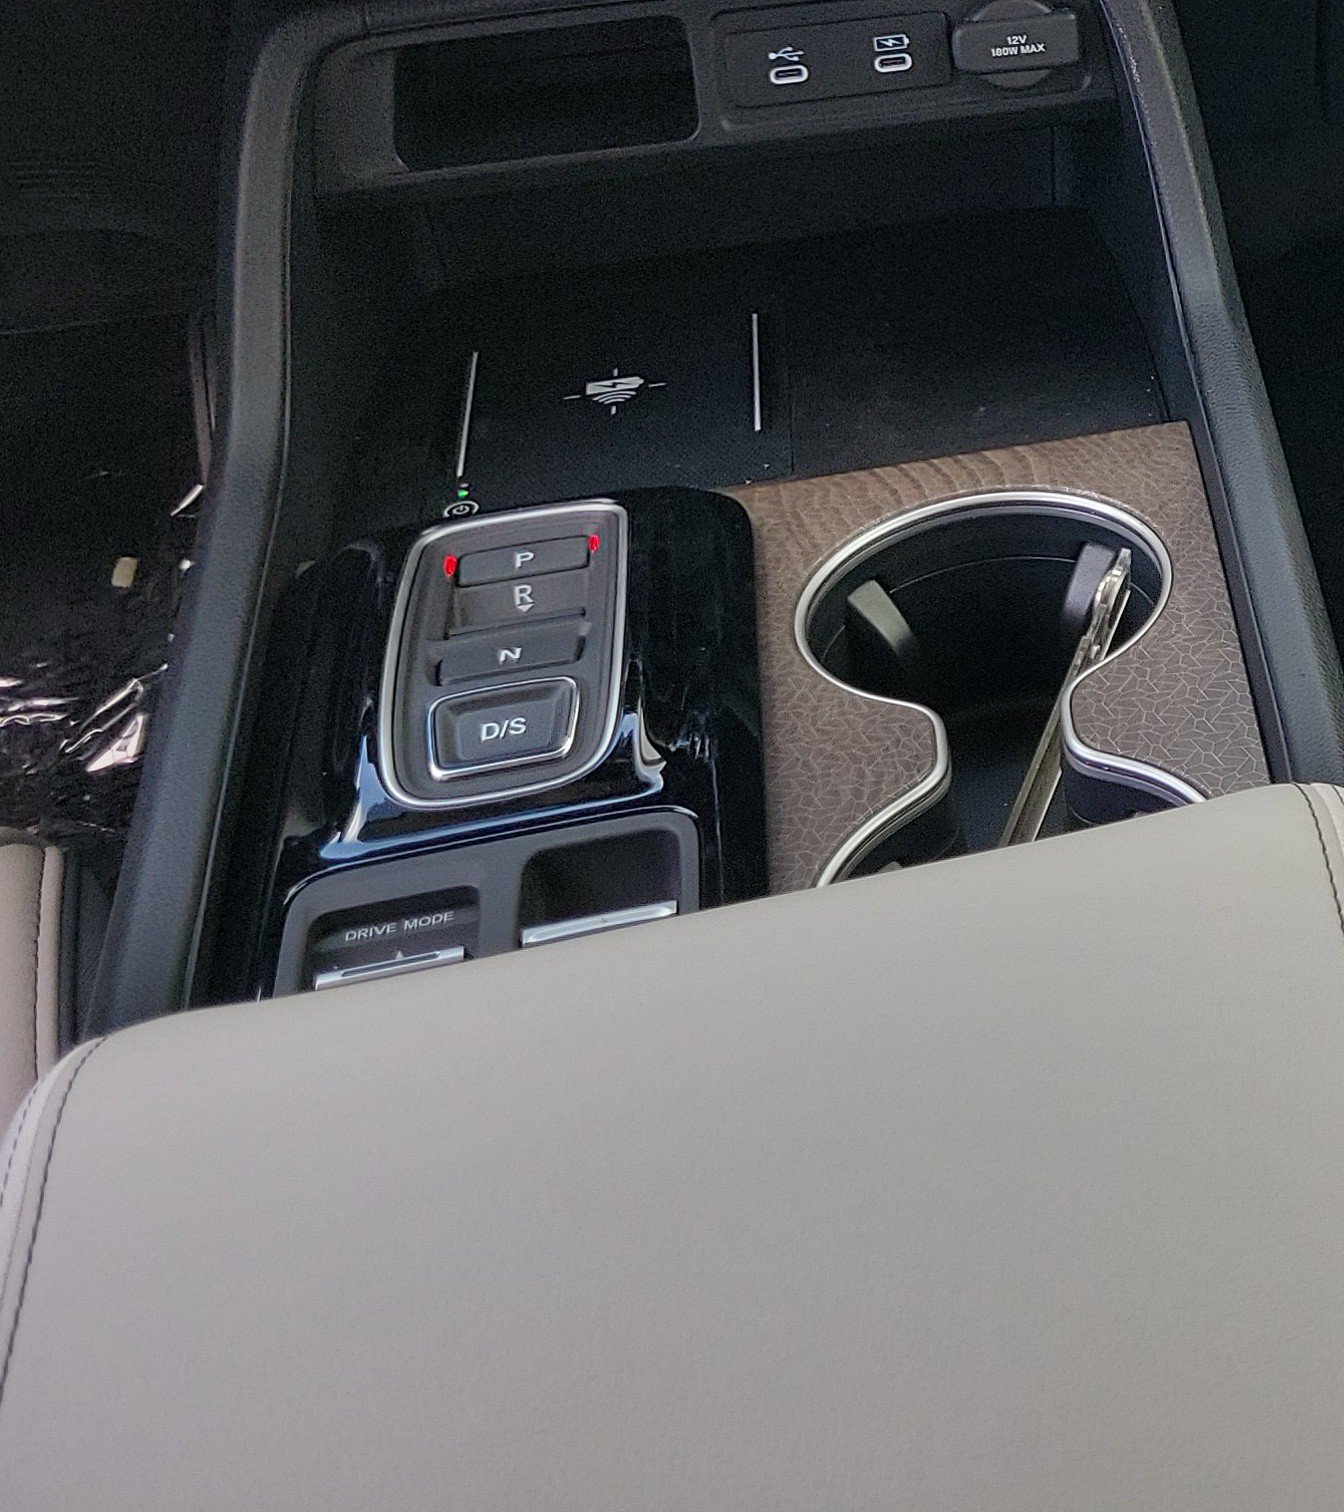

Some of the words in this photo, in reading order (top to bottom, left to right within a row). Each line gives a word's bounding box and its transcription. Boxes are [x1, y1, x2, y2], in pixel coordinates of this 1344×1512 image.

[1006, 34, 1028, 46] 12V
[990, 44, 1019, 58] 180W
[1020, 42, 1046, 56] MAX
[514, 551, 535, 569] P
[514, 585, 532, 605] R
[499, 647, 522, 662] N
[481, 717, 527, 741] D/S
[345, 922, 397, 941] DRIVE
[403, 911, 455, 931] MODE
